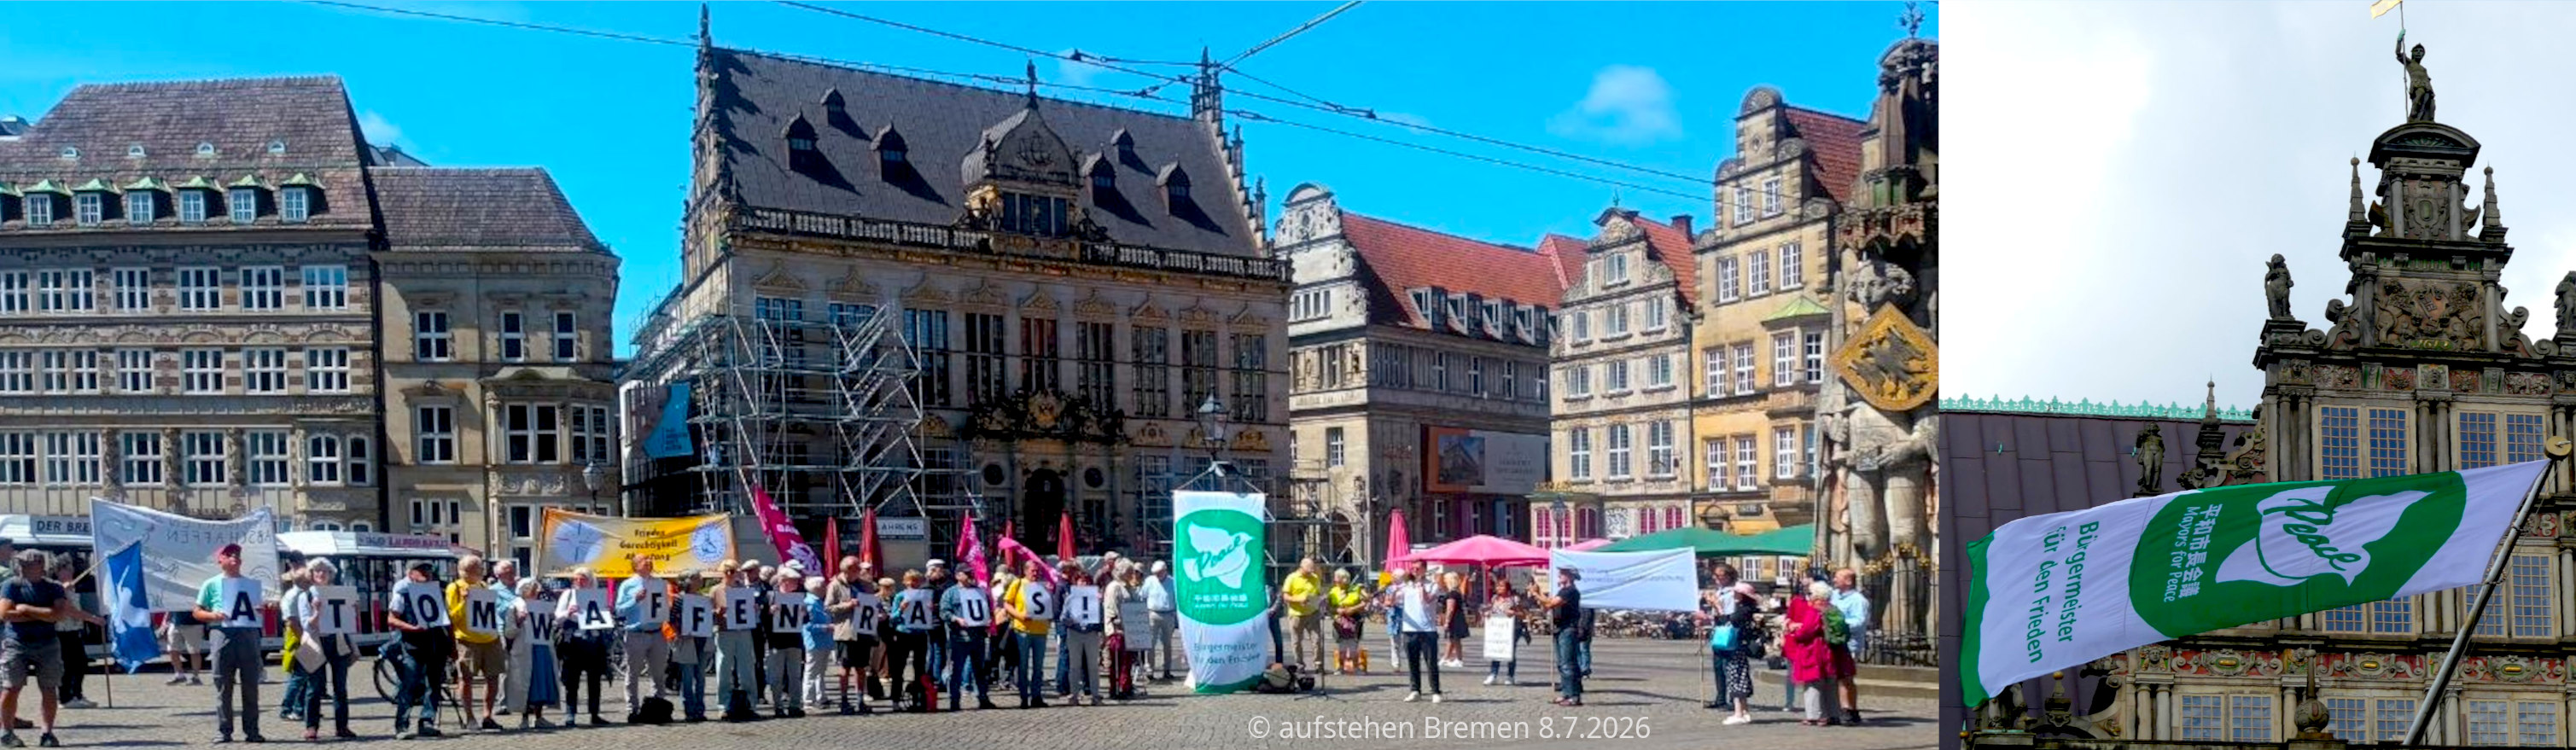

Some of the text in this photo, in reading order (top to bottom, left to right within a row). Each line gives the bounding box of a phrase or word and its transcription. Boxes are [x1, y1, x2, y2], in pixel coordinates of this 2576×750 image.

[36, 520, 61, 532] DER
[2263, 498, 2362, 572] Peace
[2163, 506, 2200, 602] Mayors for Peace
[2034, 560, 2058, 593] den
[2057, 520, 2100, 642] Bürgermeister
[230, 590, 257, 622] A
[328, 599, 346, 628] T
[417, 593, 440, 628] O
[472, 600, 497, 629] M
[586, 601, 605, 625] A
[650, 592, 663, 619] F
[735, 598, 748, 625] E
[778, 603, 800, 629] N
[908, 601, 928, 625] A
[967, 599, 985, 621] U
[1032, 591, 1046, 615] S
[528, 612, 553, 641] W
[691, 606, 706, 632] F
[859, 607, 876, 631] R
[2026, 595, 2050, 663] Frieden
